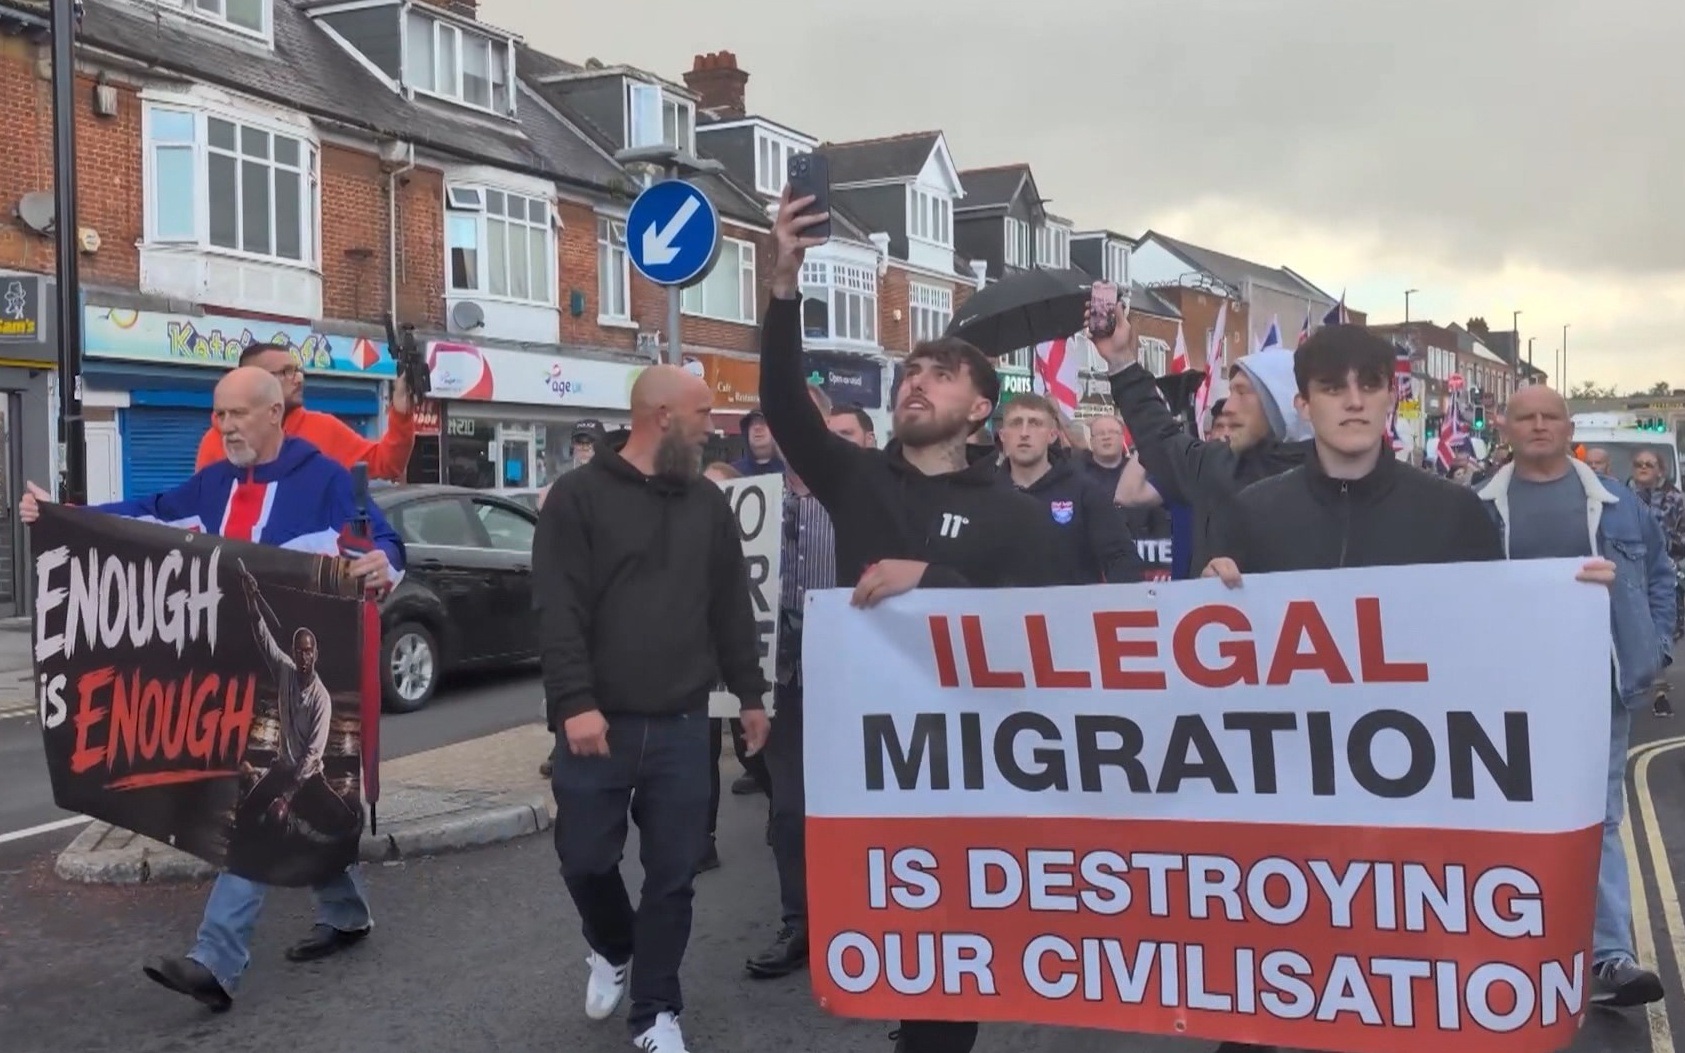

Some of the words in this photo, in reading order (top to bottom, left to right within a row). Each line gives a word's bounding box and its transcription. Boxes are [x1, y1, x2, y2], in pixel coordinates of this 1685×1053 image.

[36, 546, 224, 662] ENOUGH
[927, 597, 1429, 690] ILLEGAL
[71, 667, 256, 774] ENOUGH
[861, 709, 1534, 803] MIGRATION
[867, 847, 943, 911] IS
[967, 848, 1546, 940] DESTROYING
[825, 930, 1001, 996] OUR
[1021, 934, 1586, 1034] CIVILISATION
